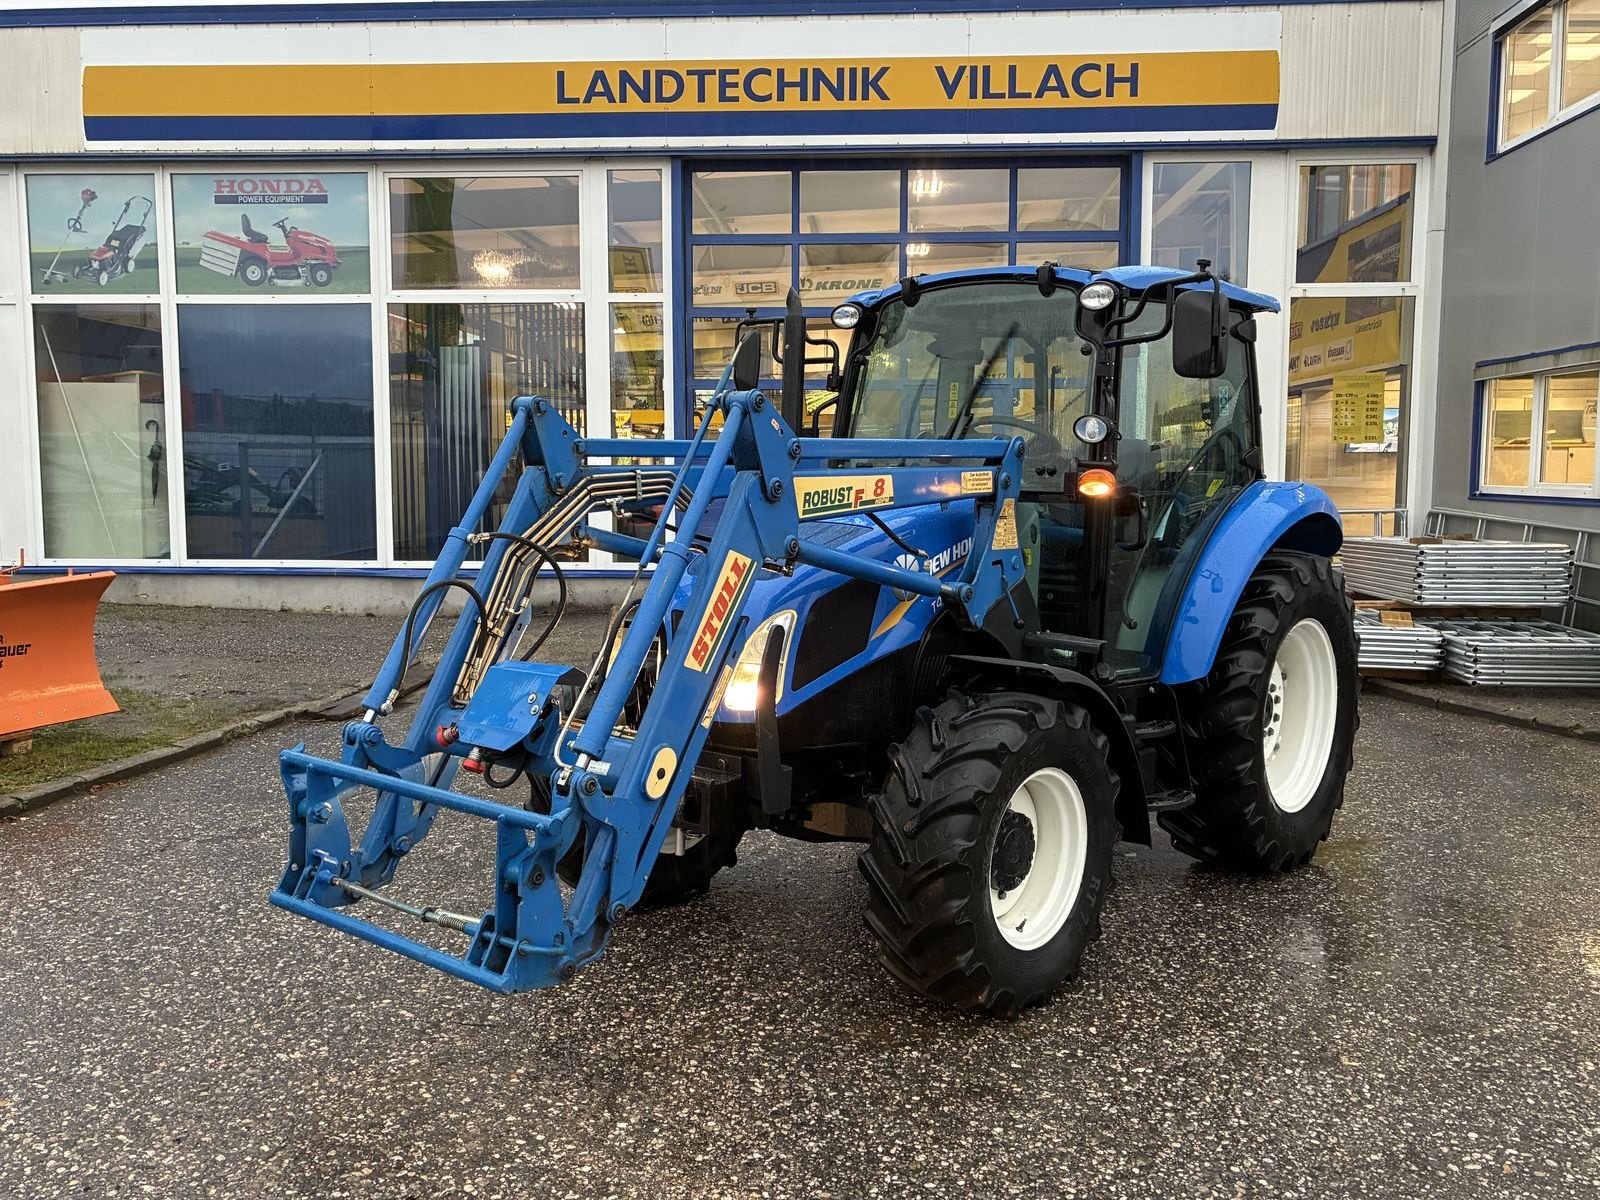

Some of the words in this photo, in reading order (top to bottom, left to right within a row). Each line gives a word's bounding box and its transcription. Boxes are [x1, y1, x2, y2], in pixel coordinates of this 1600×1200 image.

[556, 66, 890, 104] LANDTECHNIK
[935, 62, 1139, 100] VILLACH
[214, 178, 328, 194] HONDA
[238, 195, 263, 203] POWER
[265, 195, 304, 203] EQUIPMENT
[736, 282, 776, 294] JCB
[815, 278, 883, 291] KRONE
[802, 486, 853, 509] ROBUST
[853, 489, 864, 508] F
[873, 478, 885, 497] 8
[692, 557, 747, 667] STOLL
